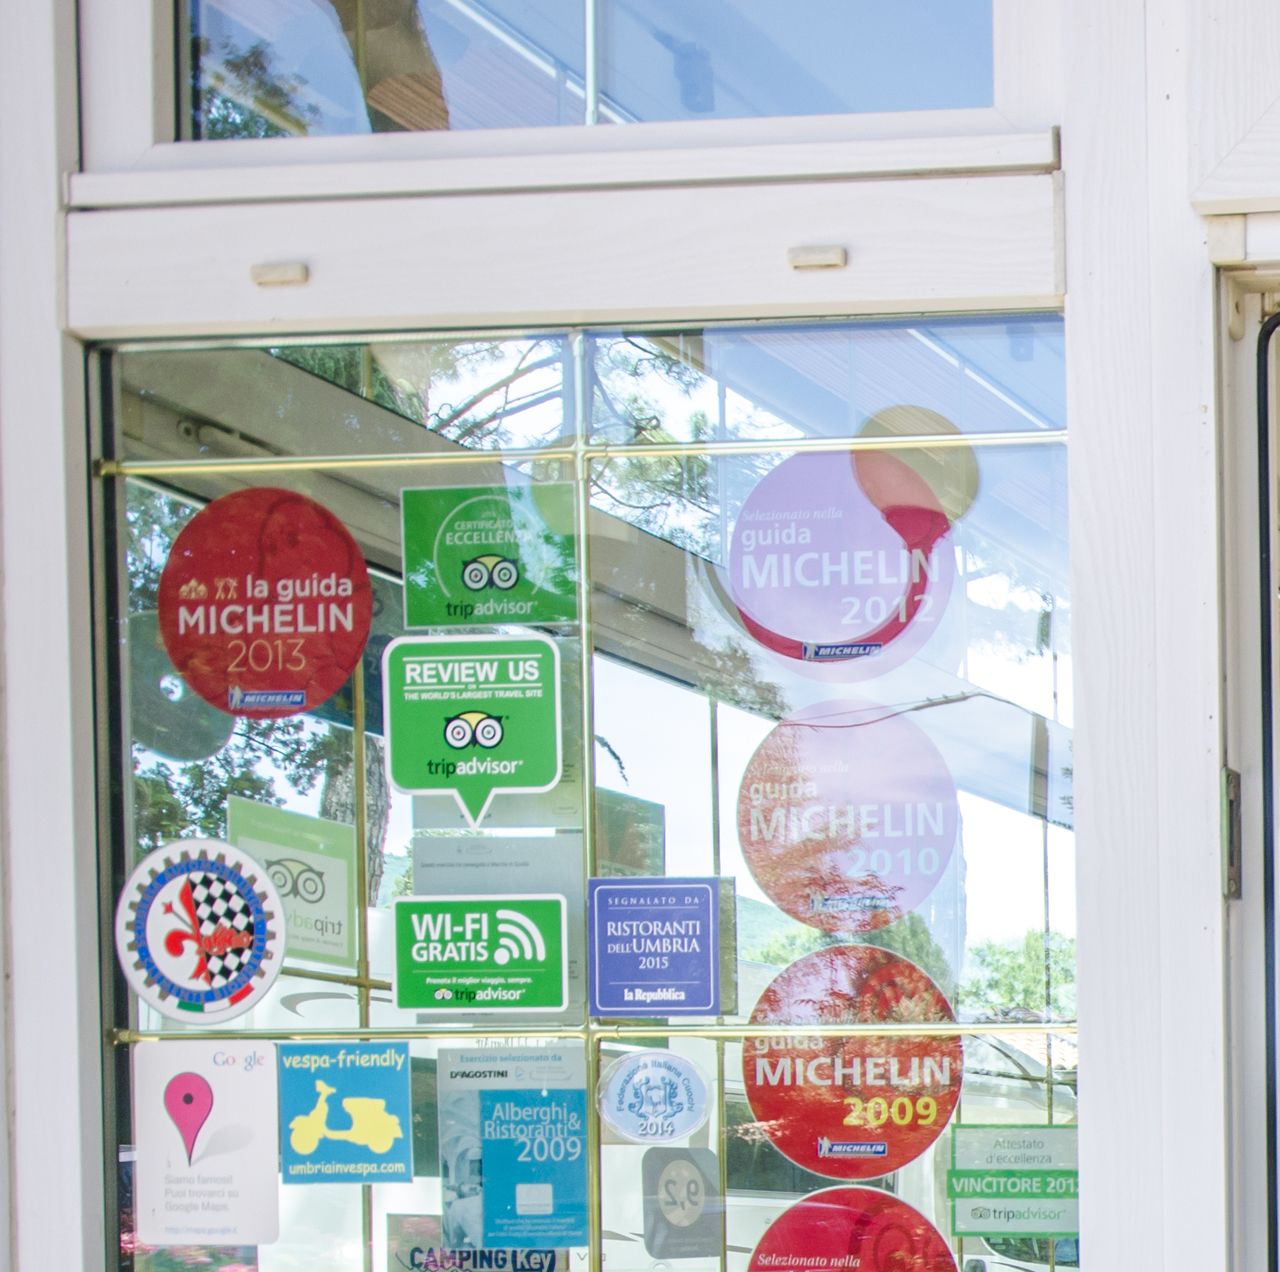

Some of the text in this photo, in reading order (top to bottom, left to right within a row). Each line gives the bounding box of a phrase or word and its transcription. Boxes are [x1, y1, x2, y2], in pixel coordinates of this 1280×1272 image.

[742, 506, 843, 521] Selezionato nella
[446, 530, 533, 546] ECCELLEN
[741, 522, 812, 551] guida
[741, 548, 941, 590] MICHELIN
[246, 572, 353, 602] la guida
[446, 599, 534, 619] tripadvisor
[840, 594, 936, 627] 2012
[178, 603, 354, 636] MICHELIN
[227, 639, 307, 673] 2013
[818, 644, 881, 656] MICHELIN
[405, 660, 540, 684] REVIEW US
[243, 693, 304, 706] MICHELIN
[404, 689, 543, 700] THE WORLD'S LARGEST TRAVEL SITE
[427, 756, 518, 779] tripadvisor
[750, 778, 818, 805] guida
[750, 802, 945, 842] MICHELIN
[848, 847, 941, 877] 2010
[608, 896, 700, 905] SEGNALATO DA
[411, 913, 489, 941] WI-FI
[607, 920, 701, 936] RISTORANTI
[411, 941, 489, 962] GRATIS
[607, 938, 701, 953] DELL'UMBRIA
[638, 956, 669, 969] 2015
[455, 987, 521, 1003] tripadvisor
[624, 988, 686, 1003] la Repubblica
[753, 1035, 825, 1054] guida
[283, 1050, 406, 1072] vespa-friendly
[550, 1053, 562, 1062] da
[755, 1056, 951, 1087] MICHELIN
[682, 1076, 696, 1112] Cuochi
[492, 1102, 581, 1131] Alberghi &
[842, 1096, 938, 1127] 2009
[484, 1118, 568, 1140] Ristoranti
[638, 1121, 675, 1137] 2014
[517, 1138, 582, 1162] 2009
[831, 1143, 886, 1154] MICHELIN
[993, 1137, 1045, 1151] Attestato
[985, 1151, 1053, 1165] d'eccellenza
[288, 1161, 406, 1177] umbriainvespa.com
[952, 1176, 1080, 1194] VINCITORE 201
[164, 1202, 199, 1213] Google
[991, 1204, 1062, 1222] tripadvisor
[409, 1247, 553, 1272] CAMPING Key
[757, 1253, 861, 1268] Selezionato nella
